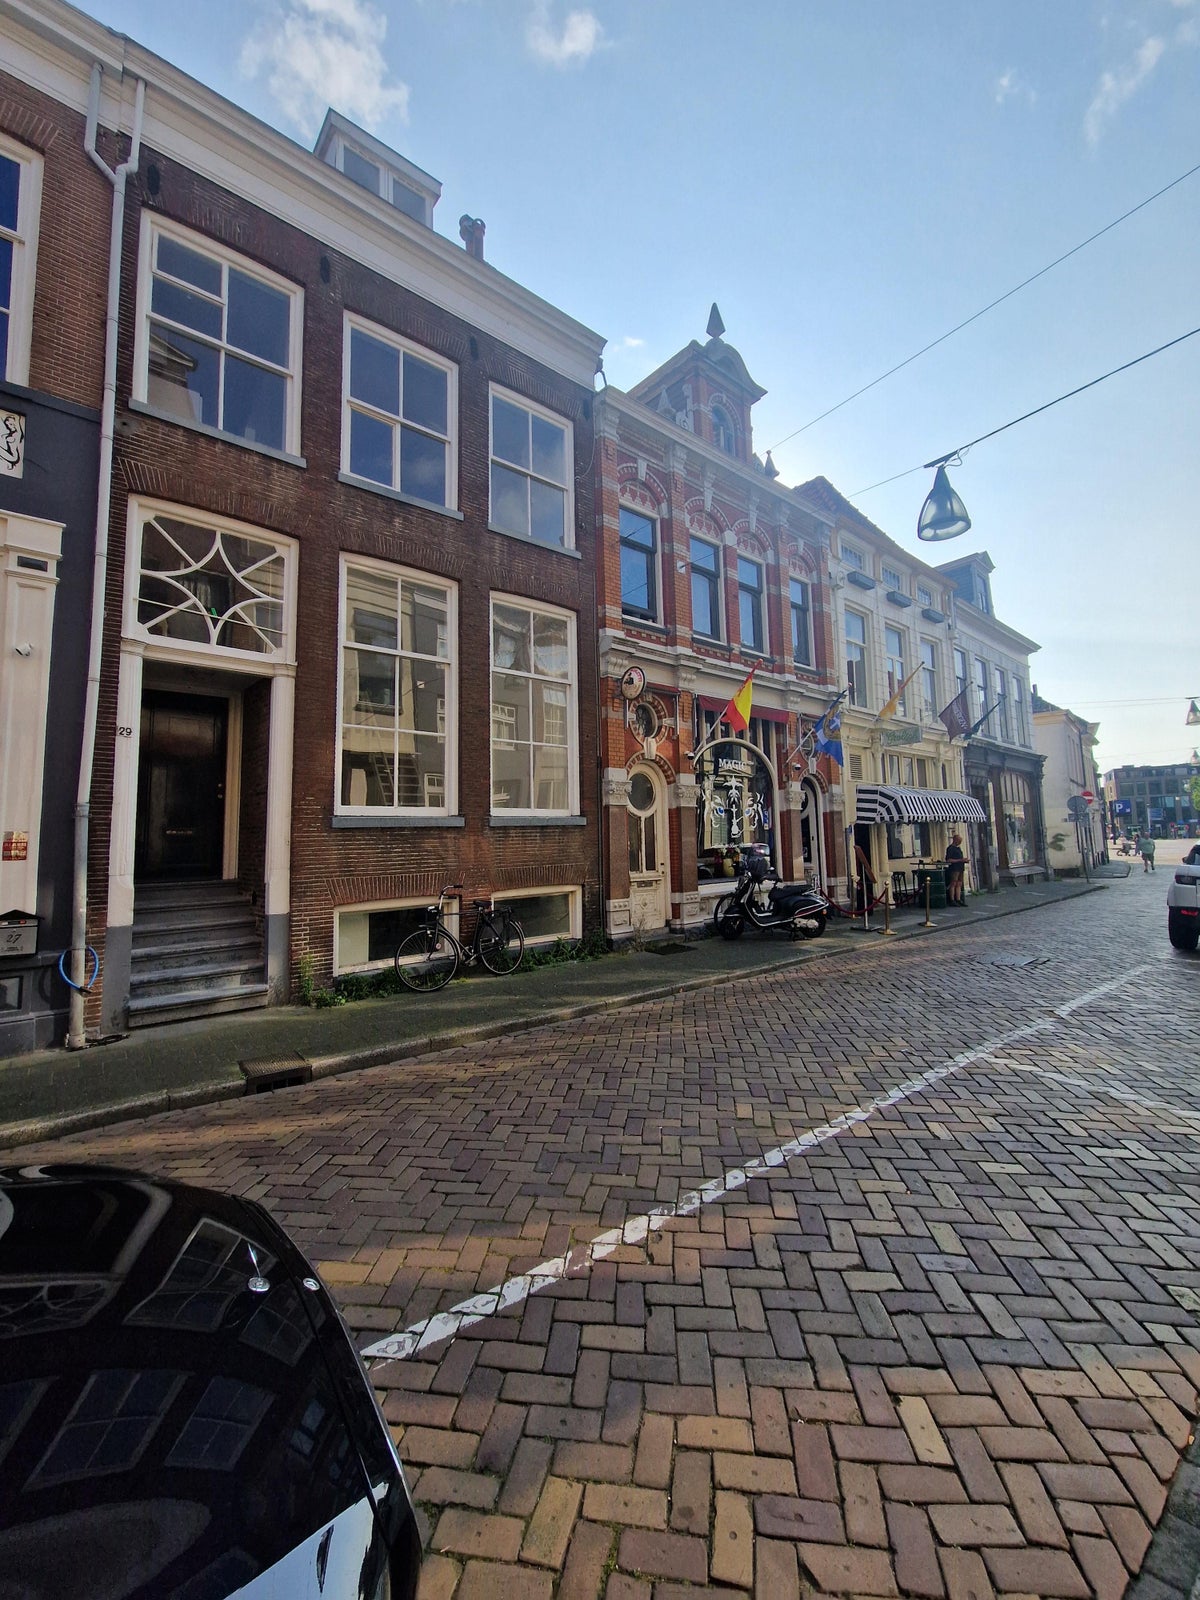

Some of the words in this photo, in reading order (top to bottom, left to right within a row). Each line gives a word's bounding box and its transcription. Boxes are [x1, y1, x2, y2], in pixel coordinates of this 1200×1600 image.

[118, 726, 133, 736] 29
[718, 758, 747, 770] MAGIC
[1115, 803, 1124, 813] P
[6, 933, 23, 944] 27
